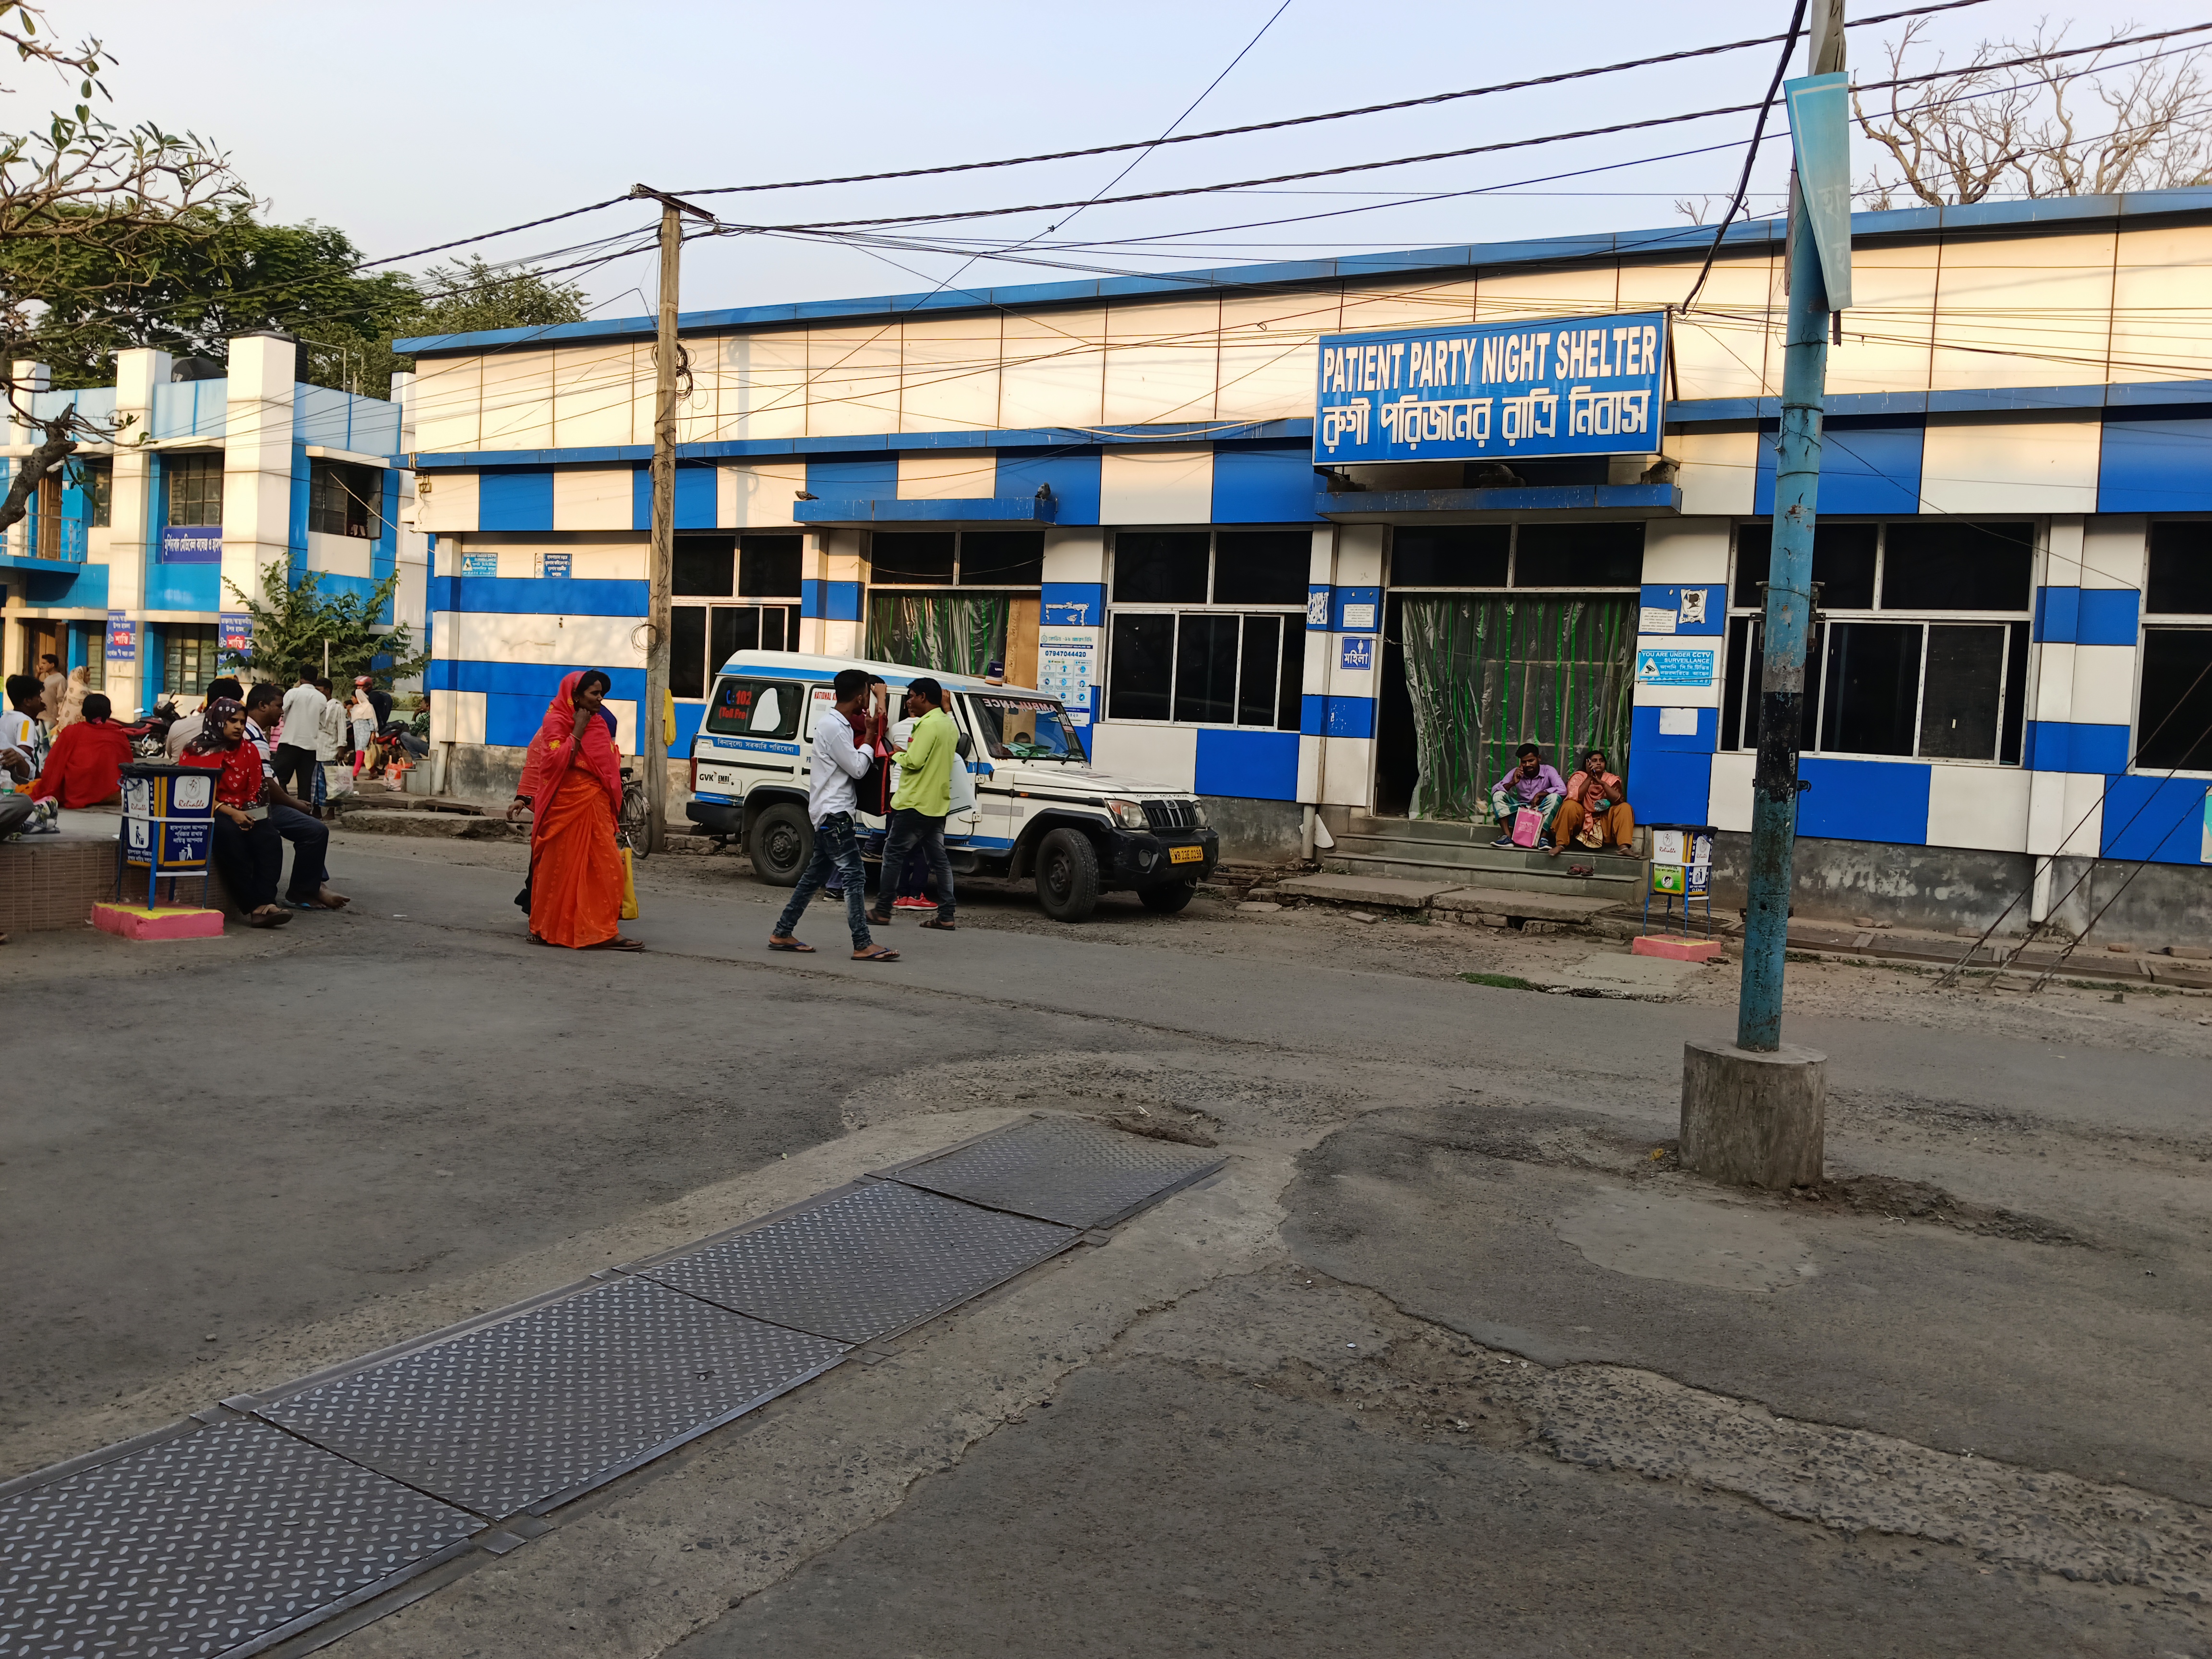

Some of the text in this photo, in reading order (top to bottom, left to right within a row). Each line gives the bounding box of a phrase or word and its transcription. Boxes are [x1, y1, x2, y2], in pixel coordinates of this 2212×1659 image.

[1322, 325, 1657, 393] PATIENT PARTY NIGHT SHELTER
[1381, 394, 1493, 450] পরিজনের
[1502, 387, 1559, 447] রাত্রি
[1568, 385, 1651, 437] নিবাস
[1344, 649, 1369, 666] মহিলা
[736, 690, 752, 705] 102
[814, 692, 831, 700] NATIONAL
[719, 706, 734, 720] (Toll
[717, 737, 743, 747] বিনামূল্যে
[745, 741, 767, 750] সরকারি
[699, 773, 714, 781] GVK
[131, 803, 147, 811] Reliable
[179, 799, 204, 808] Reliable
